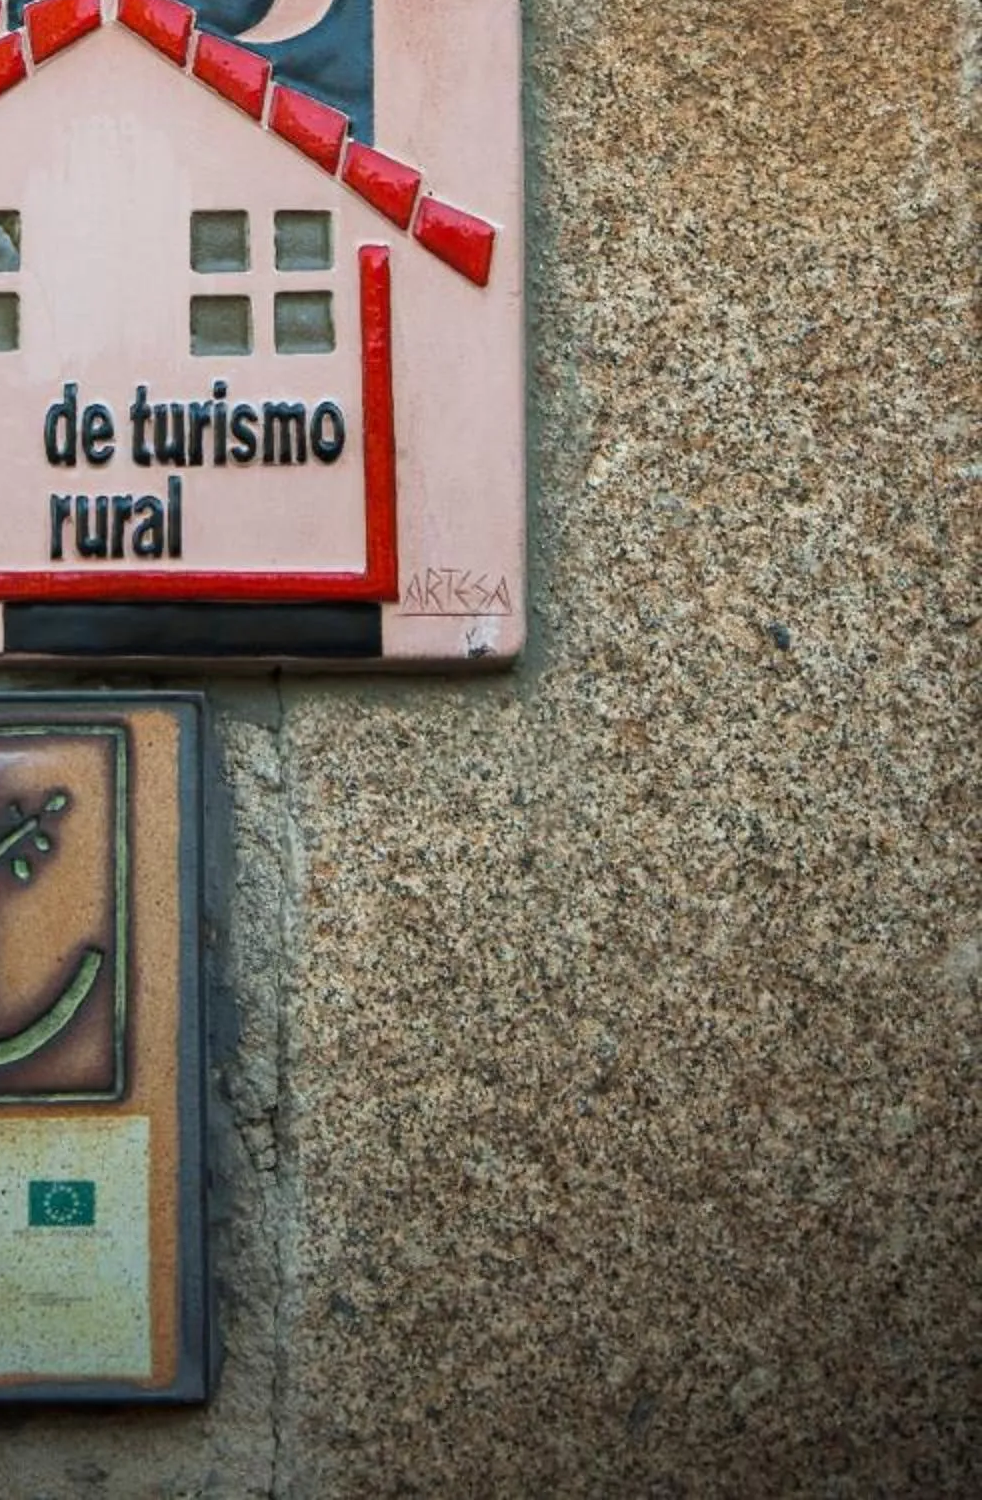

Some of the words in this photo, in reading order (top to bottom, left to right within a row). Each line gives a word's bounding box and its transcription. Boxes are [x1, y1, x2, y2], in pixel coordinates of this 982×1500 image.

[44, 382, 116, 468] de
[130, 381, 347, 467] turismo
[48, 477, 183, 560] rural
[402, 566, 513, 614] ARTESA
